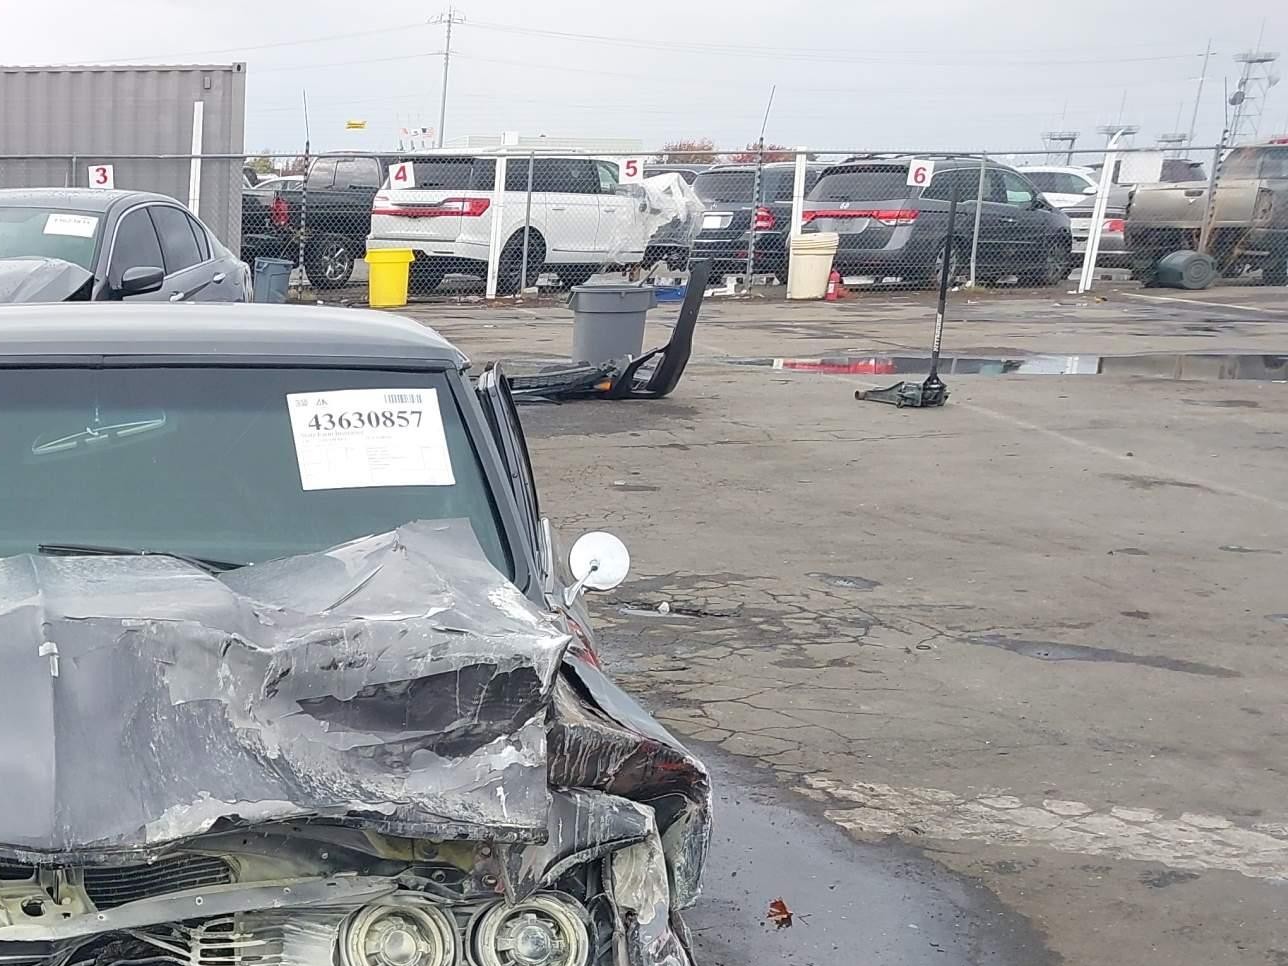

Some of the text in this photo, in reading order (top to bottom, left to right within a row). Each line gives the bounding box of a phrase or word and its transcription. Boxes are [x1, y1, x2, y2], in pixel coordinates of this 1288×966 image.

[95, 167, 108, 184] 3
[394, 165, 408, 182] 4
[625, 160, 638, 177] 5
[913, 167, 926, 184] 6
[308, 410, 423, 431] 43630857
